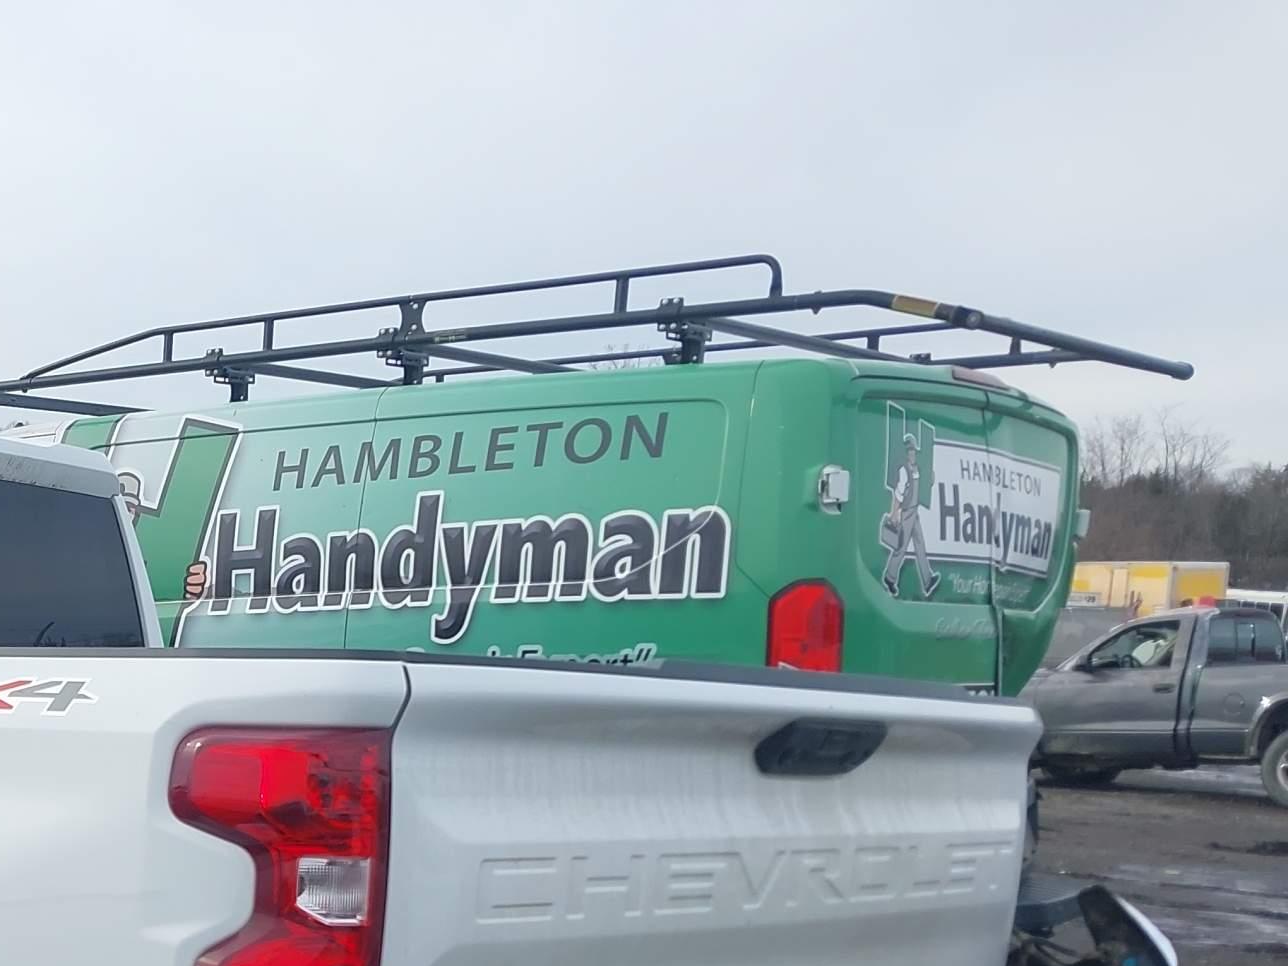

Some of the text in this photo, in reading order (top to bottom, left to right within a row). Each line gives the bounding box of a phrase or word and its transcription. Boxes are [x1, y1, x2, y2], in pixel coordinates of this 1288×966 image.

[272, 411, 669, 491] HAMBLETON
[959, 458, 1042, 497] HAMBLETON
[938, 482, 1052, 566] Handyman
[209, 491, 730, 643] Handyman
[475, 841, 1013, 924] CHEVROLET
